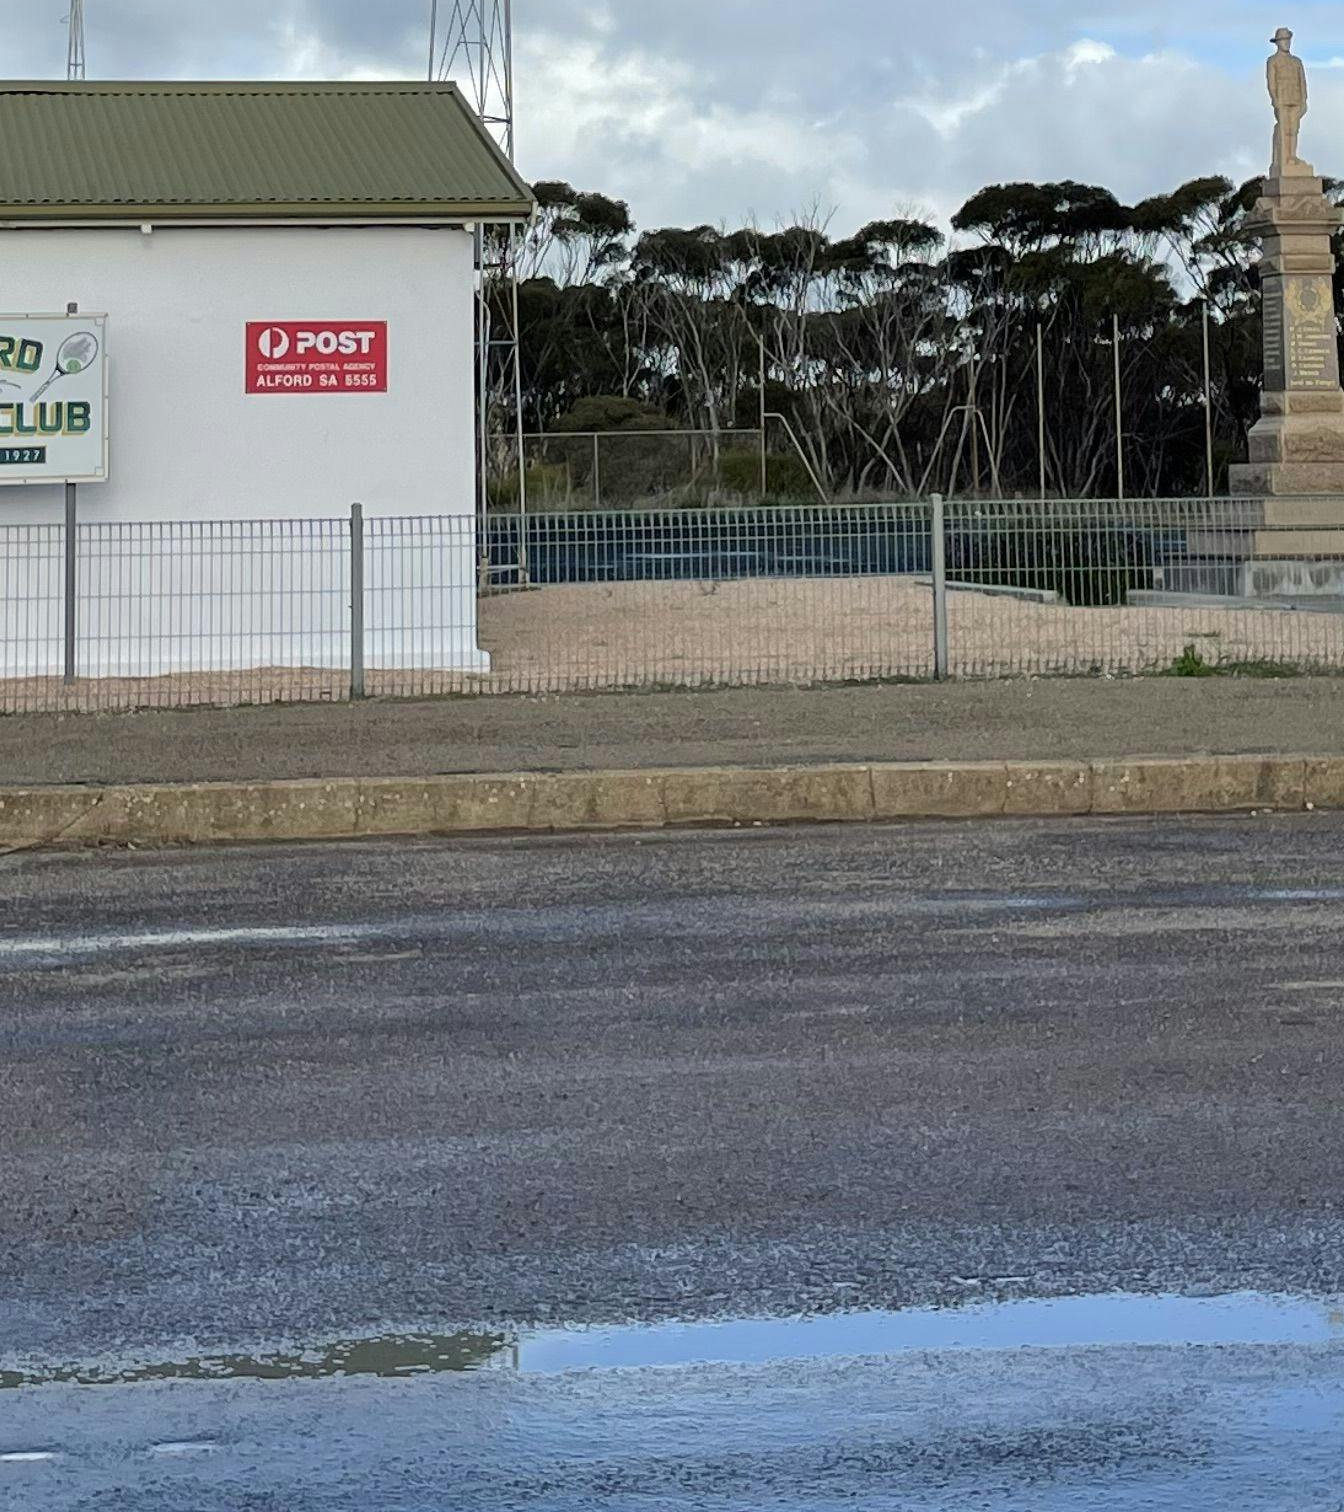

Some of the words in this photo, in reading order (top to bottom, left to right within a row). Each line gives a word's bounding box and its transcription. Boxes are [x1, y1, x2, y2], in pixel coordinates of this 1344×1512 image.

[296, 331, 375, 355] POST
[256, 363, 307, 371] COMMUNITY
[308, 363, 340, 371] POSTAL
[343, 362, 375, 370] AGENCY
[256, 374, 312, 387] ALFORD
[319, 374, 338, 386] SA
[345, 373, 377, 387] 5555
[5, 449, 41, 463] 1927
